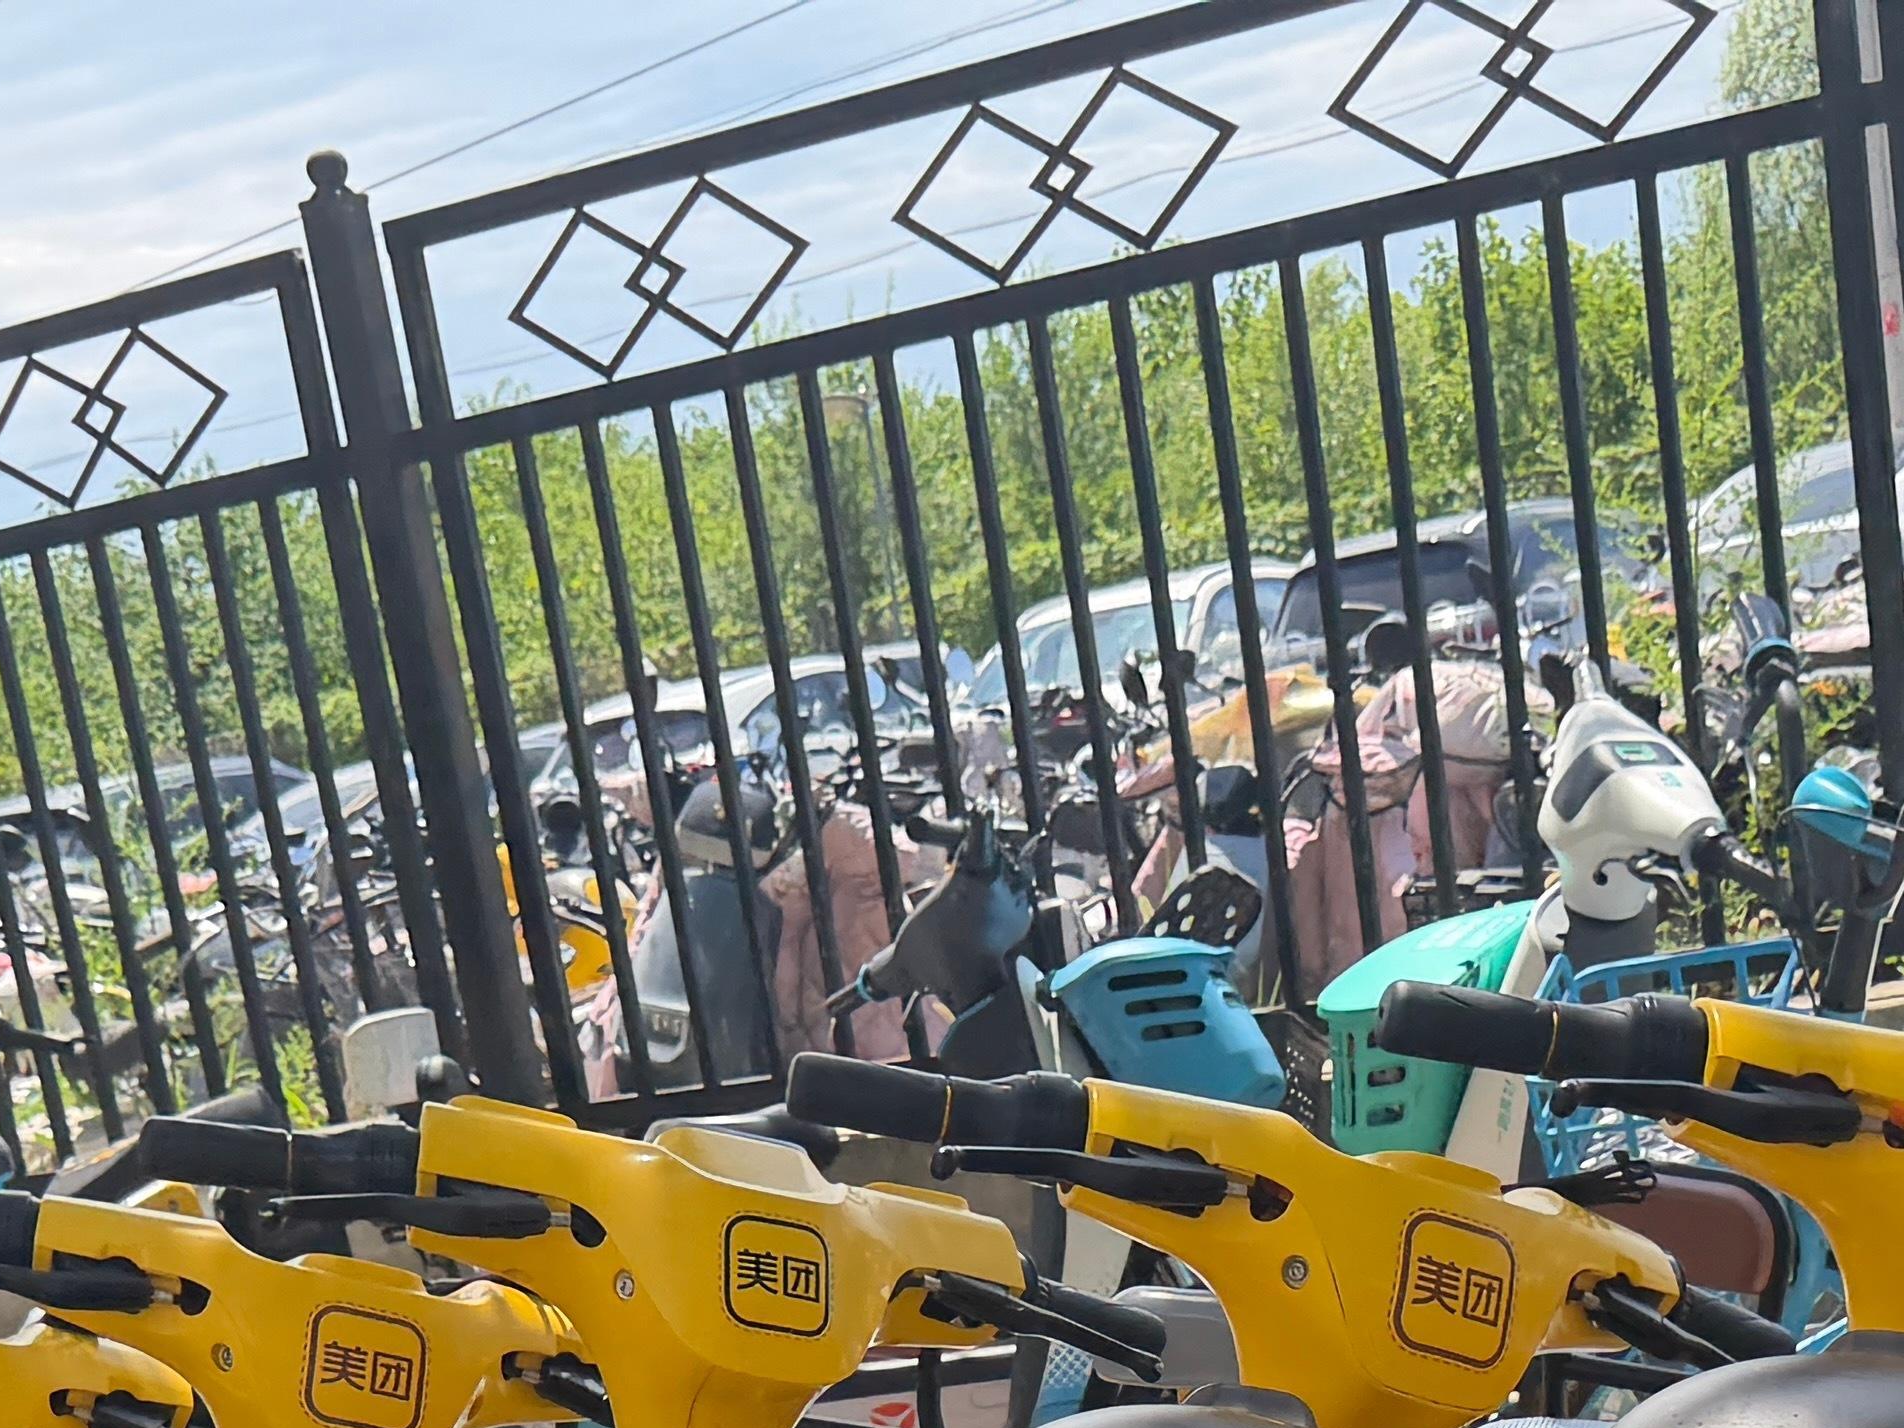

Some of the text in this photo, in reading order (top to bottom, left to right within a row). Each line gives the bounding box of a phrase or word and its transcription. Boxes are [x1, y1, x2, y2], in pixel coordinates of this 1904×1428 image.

[736, 1248, 820, 1303] 美团
[1411, 1255, 1504, 1328] 美团
[320, 1339, 413, 1401] 美团
